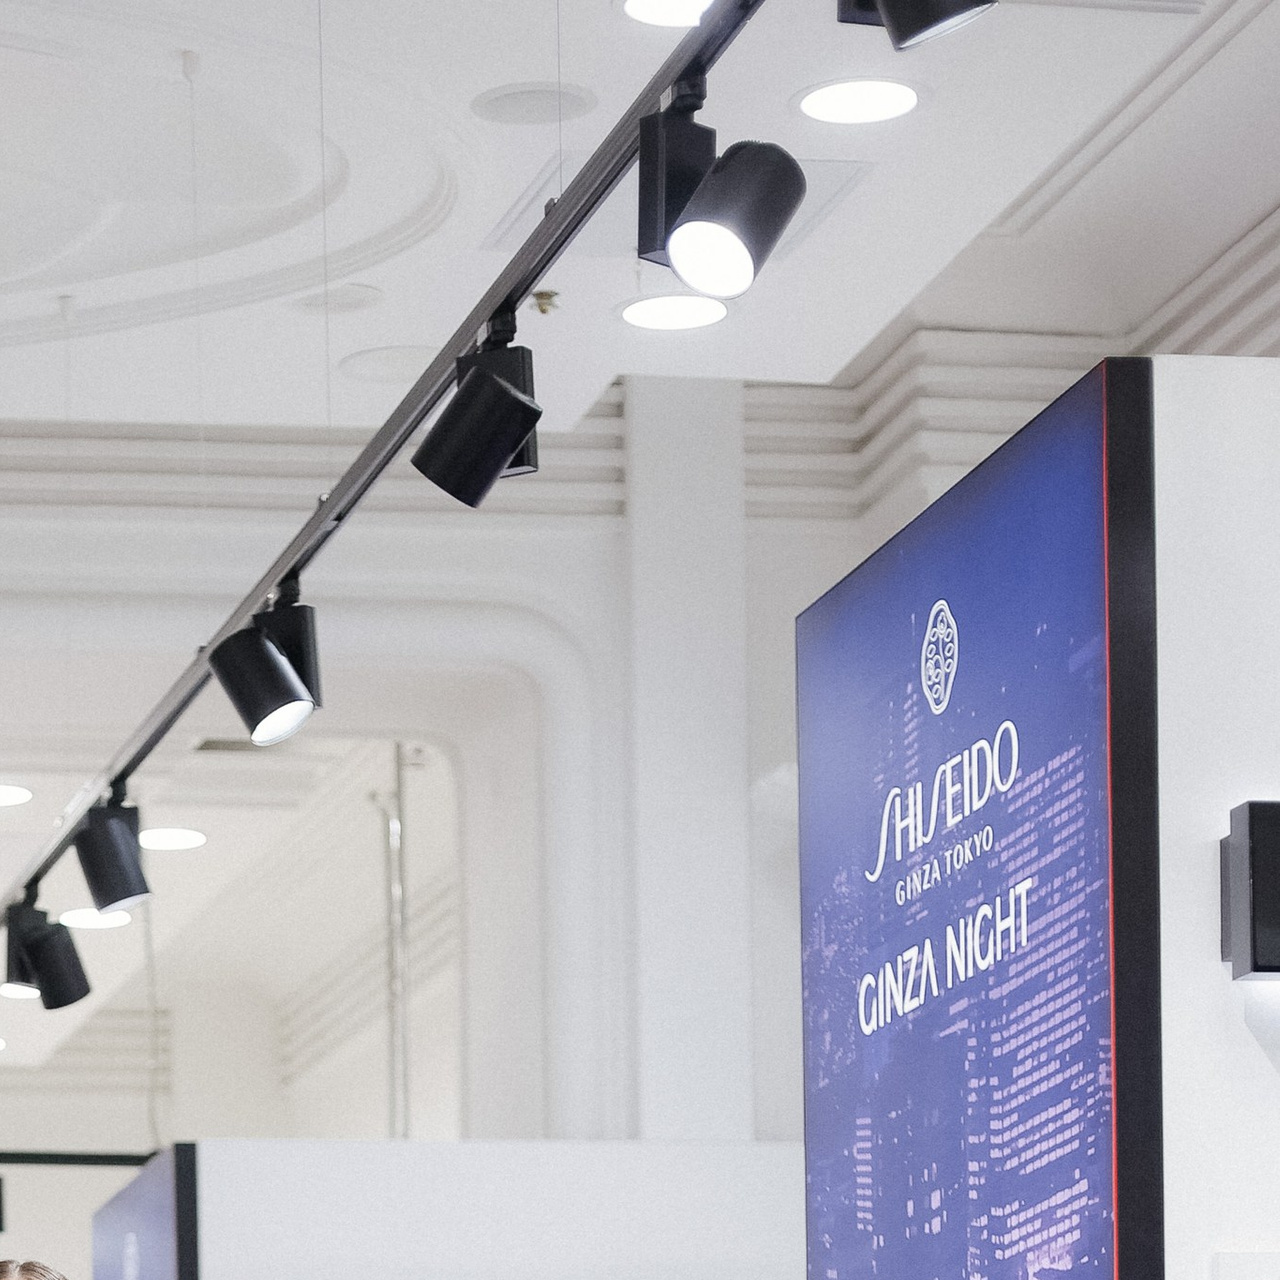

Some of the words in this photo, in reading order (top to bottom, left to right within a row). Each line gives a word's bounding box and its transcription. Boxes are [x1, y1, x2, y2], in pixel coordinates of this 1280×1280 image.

[865, 719, 1019, 882] SHISEIDO
[895, 859, 942, 906] GINZA
[944, 825, 994, 875] TOKYO
[857, 938, 939, 1036] GINZA
[946, 877, 1033, 989] NIGHT
